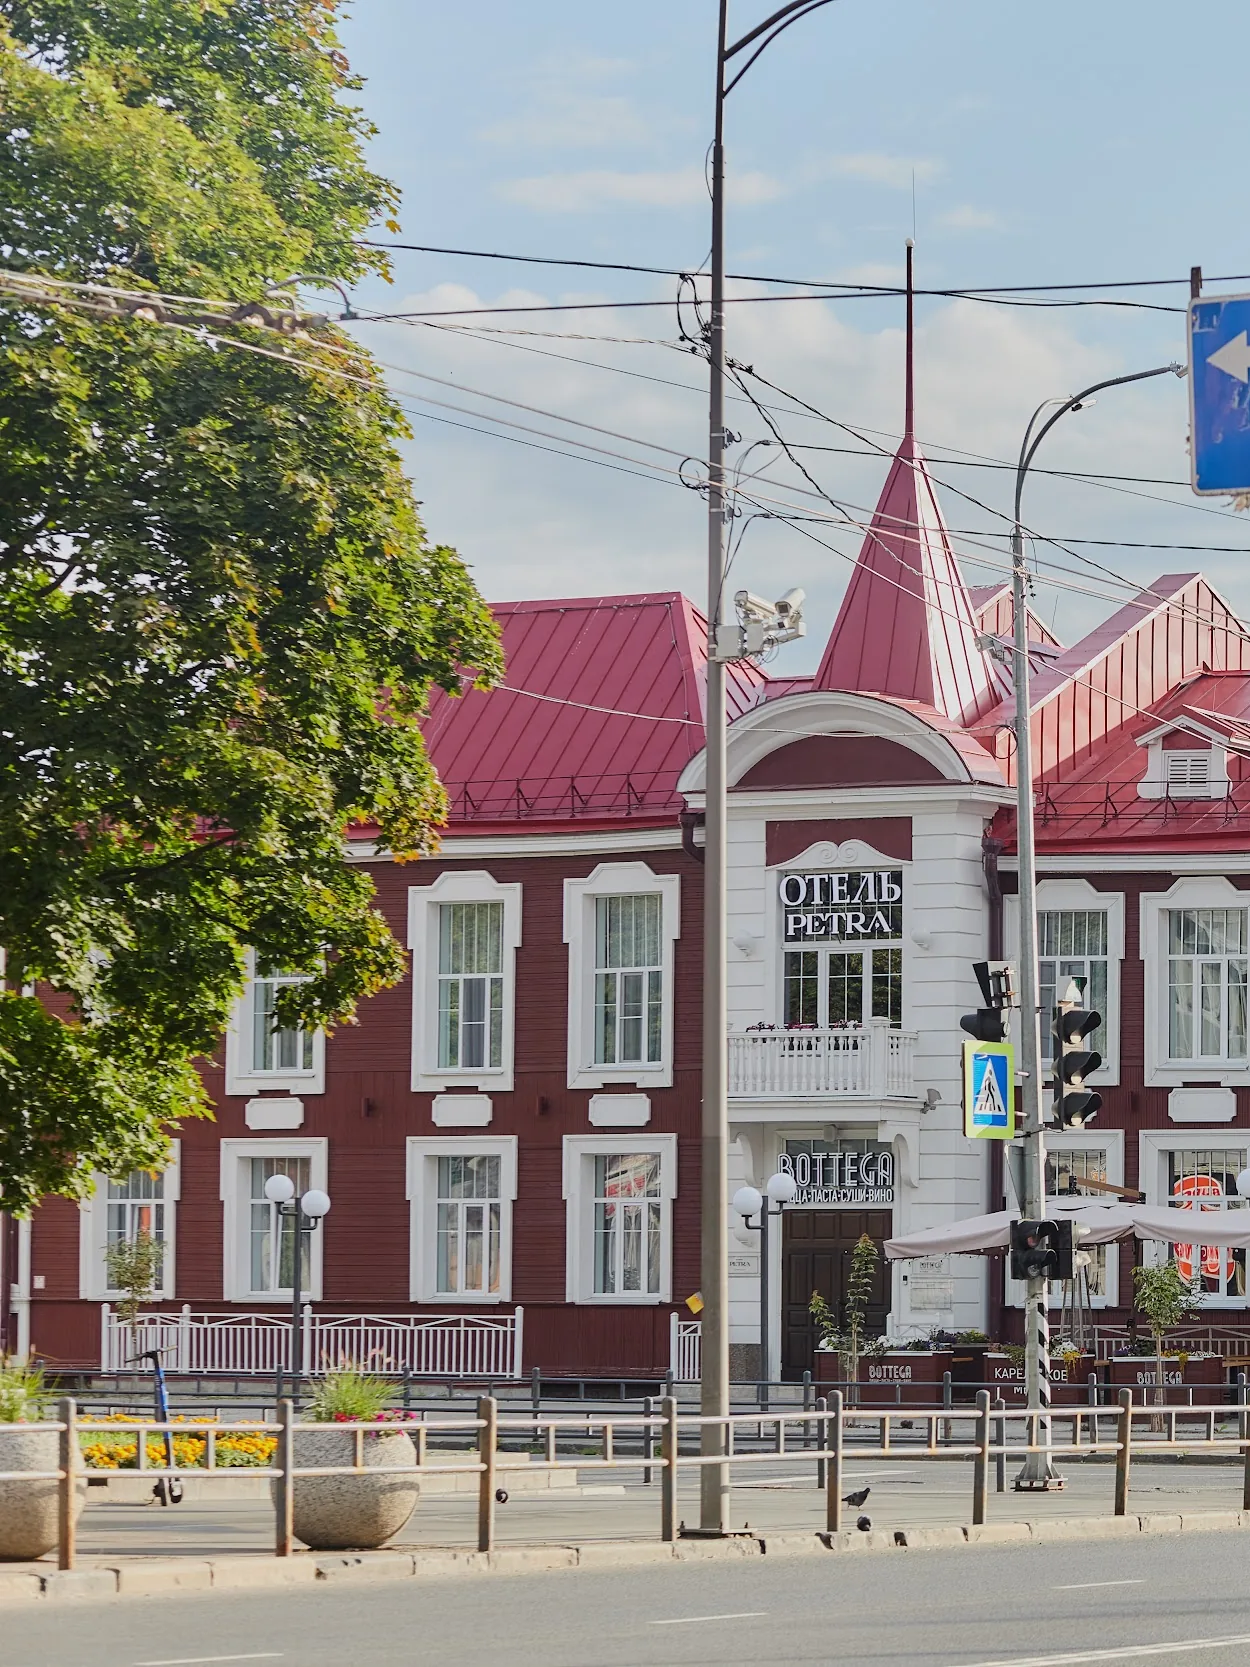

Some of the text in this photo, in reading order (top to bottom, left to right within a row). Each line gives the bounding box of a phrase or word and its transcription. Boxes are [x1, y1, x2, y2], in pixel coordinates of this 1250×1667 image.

[779, 872, 902, 906] ОТЕЛЬ
[786, 911, 893, 936] PETRA
[778, 1152, 893, 1187] BOTTEGA
[868, 1365, 912, 1379] BOTTEGA
[1136, 1371, 1183, 1384] BOTEGA
